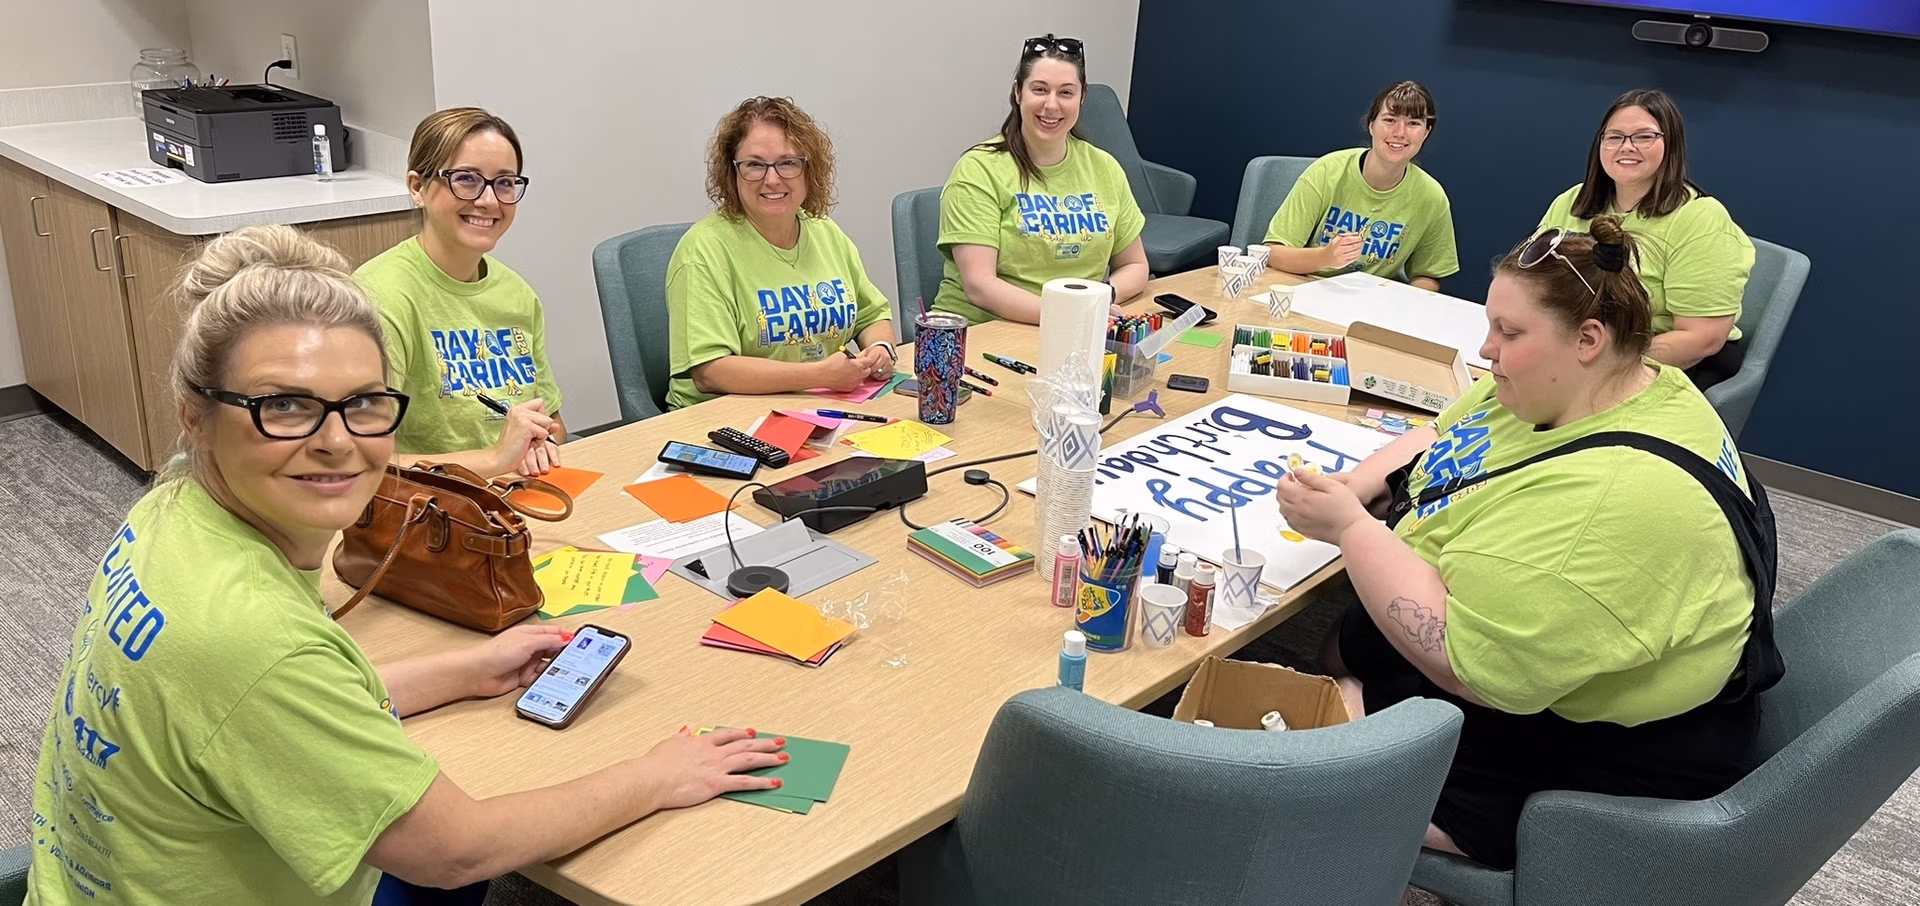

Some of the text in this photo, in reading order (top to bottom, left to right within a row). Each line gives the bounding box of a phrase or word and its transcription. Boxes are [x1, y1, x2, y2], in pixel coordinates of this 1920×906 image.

[1015, 193, 1094, 213] DAY OF
[1022, 212, 1109, 235] CARING
[1325, 206, 1369, 234] DAY
[756, 284, 812, 315] DAY
[816, 278, 846, 306] OF
[765, 303, 856, 343] CARING
[430, 328, 478, 361] DAY
[511, 326, 531, 356] 2024
[446, 356, 537, 391] CARING
[973, 542, 997, 556] 100
